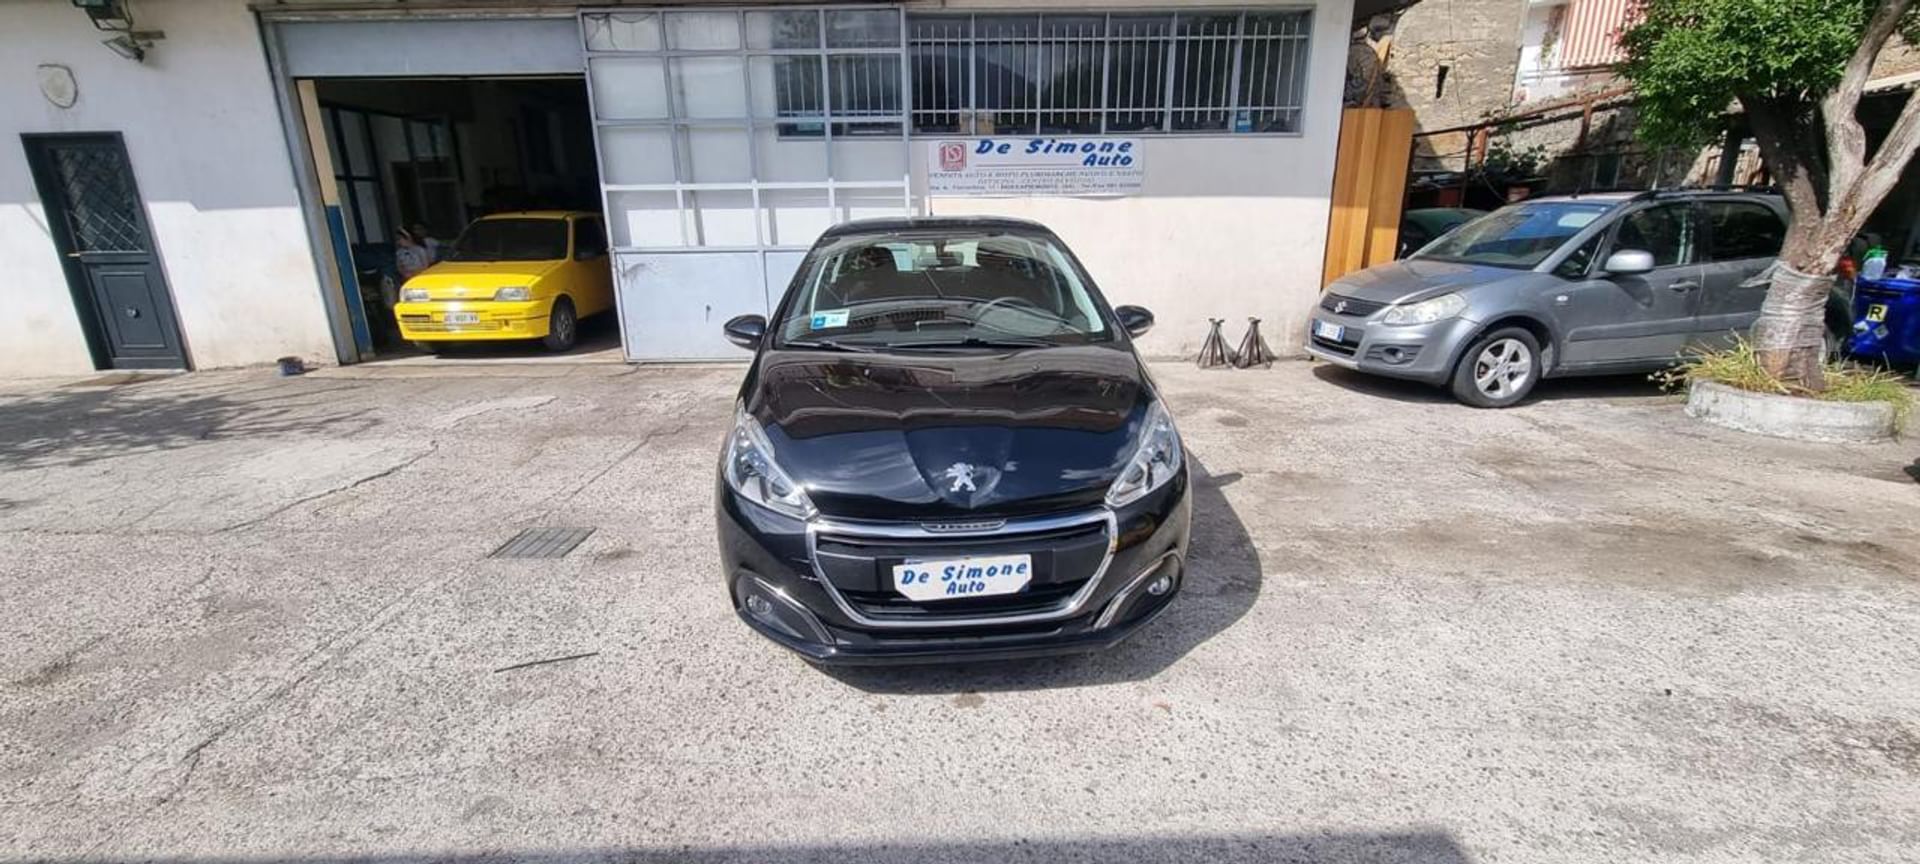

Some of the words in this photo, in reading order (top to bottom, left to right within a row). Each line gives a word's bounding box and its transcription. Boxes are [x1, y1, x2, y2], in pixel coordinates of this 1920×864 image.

[975, 139, 1011, 154] De
[1026, 139, 1132, 154] Simone
[1083, 153, 1133, 166] Auto
[1869, 306, 1882, 320] R
[901, 569, 929, 584] De
[942, 563, 1027, 581] Simone
[946, 581, 985, 594] Auto
